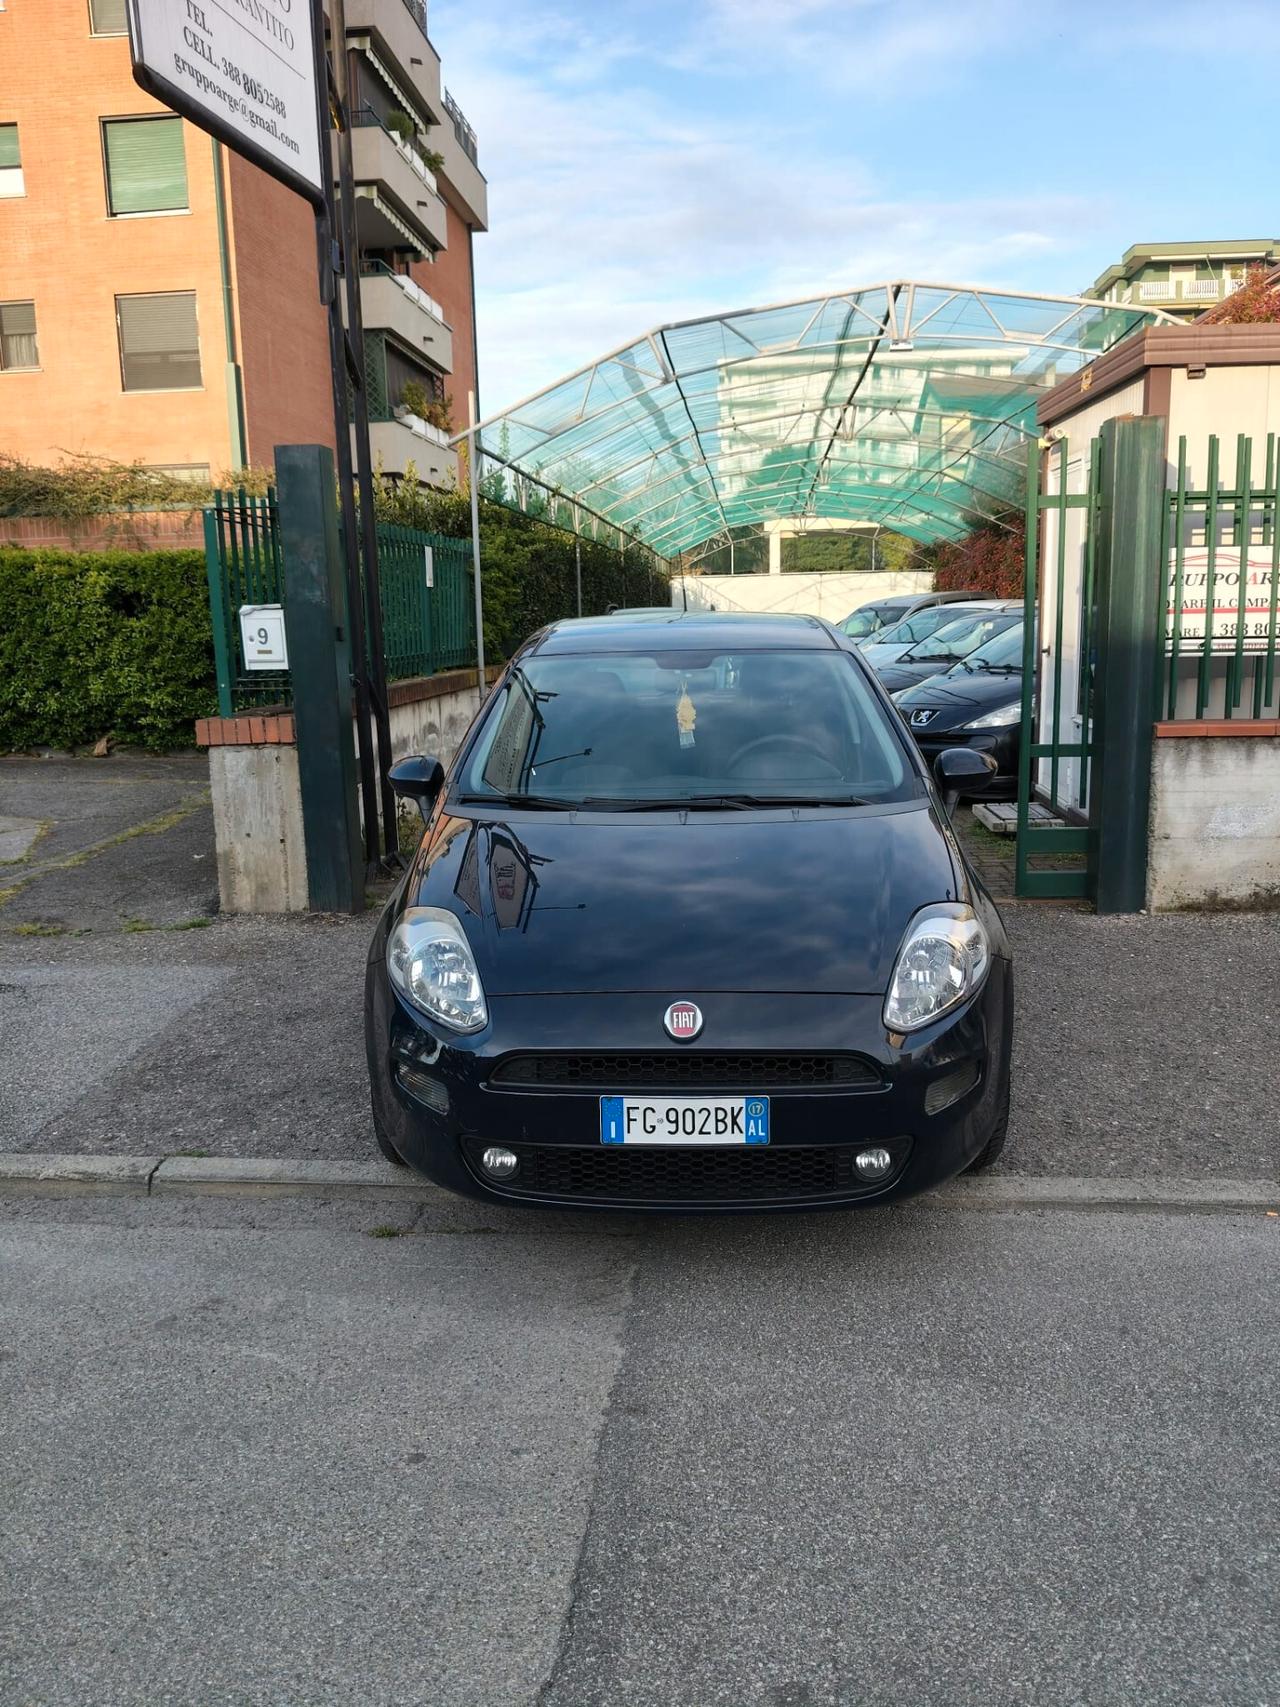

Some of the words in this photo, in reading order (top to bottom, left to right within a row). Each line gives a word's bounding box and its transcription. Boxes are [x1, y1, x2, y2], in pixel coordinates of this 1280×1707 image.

[183, 26, 220, 70] CELL.
[221, 56, 241, 88] 388
[174, 52, 300, 154] gruppoarge@gmail.com
[257, 627, 269, 645] 9
[672, 1011, 695, 1029] FIAT
[748, 1119, 766, 1136] AL
